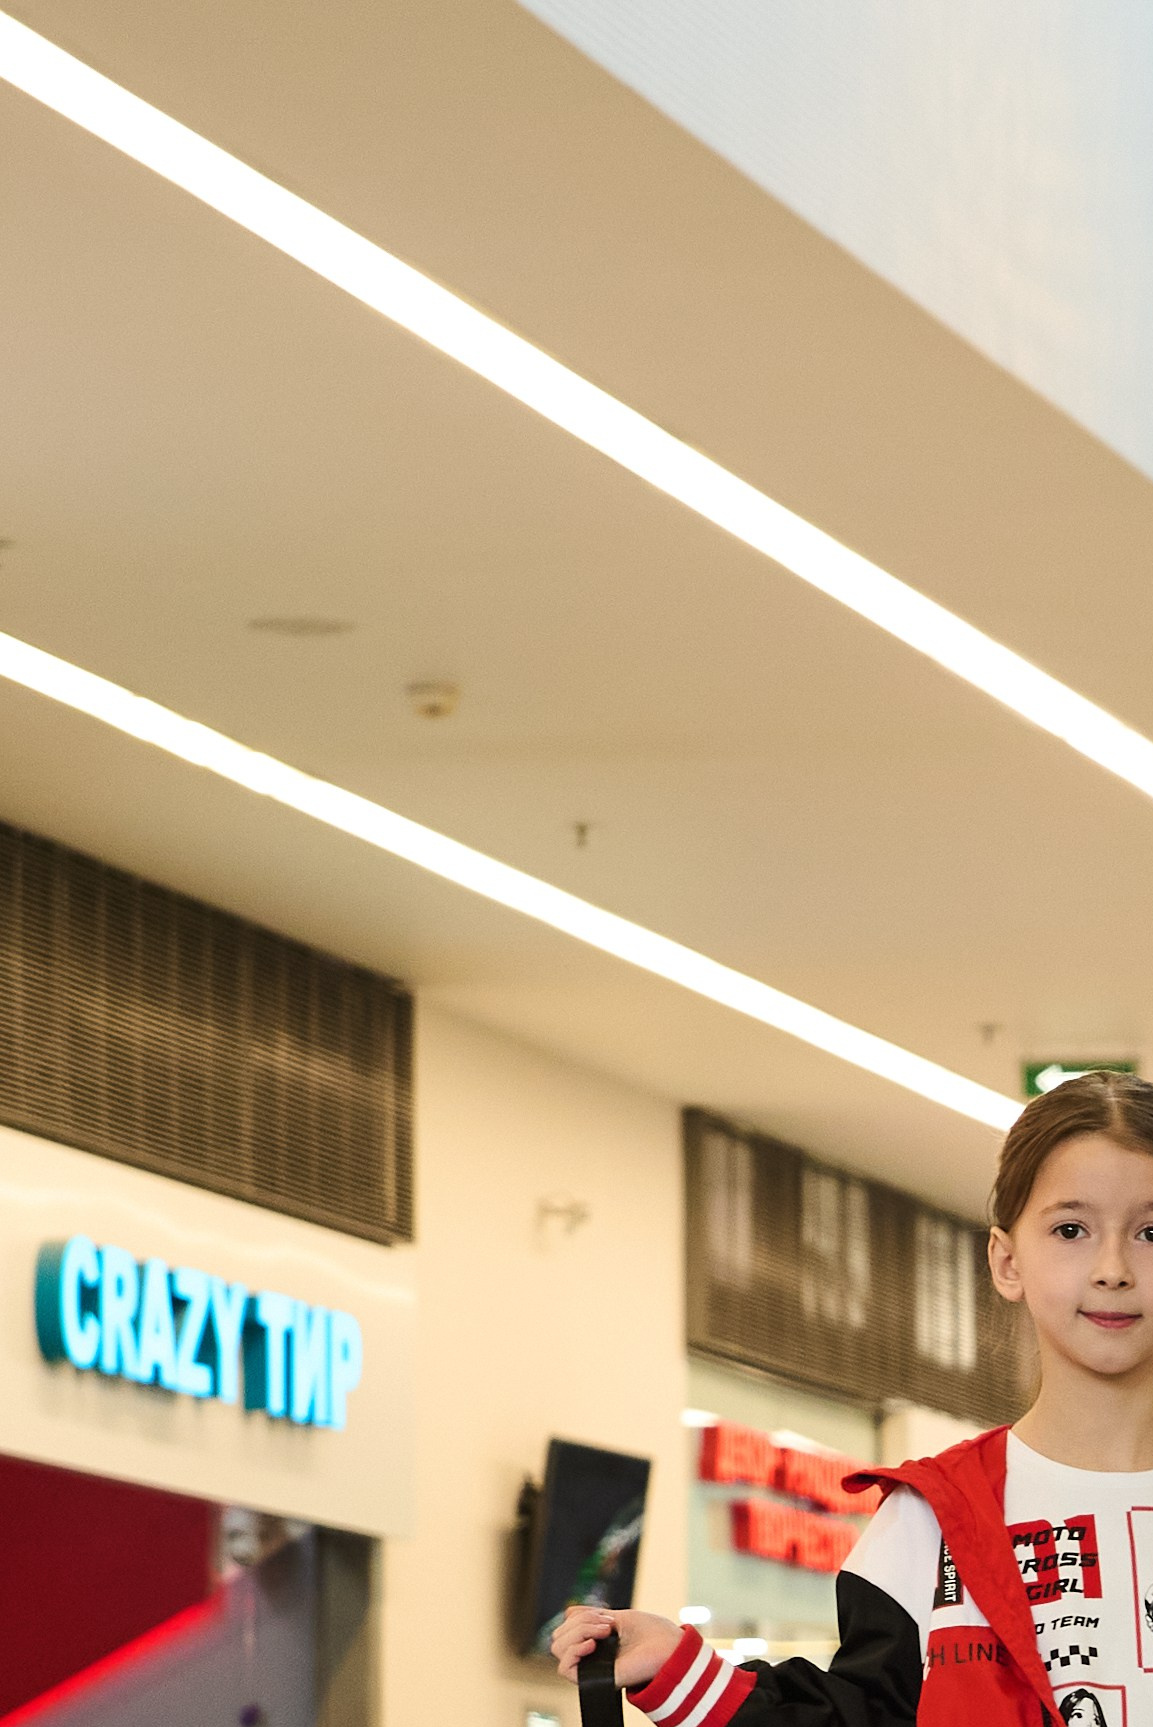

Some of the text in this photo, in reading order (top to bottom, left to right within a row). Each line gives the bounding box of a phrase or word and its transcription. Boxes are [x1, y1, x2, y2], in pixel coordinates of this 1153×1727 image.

[58, 1234, 249, 1404] CRAZY
[1012, 1526, 1086, 1549] MOTO
[1017, 1552, 1098, 1574] ROSS
[943, 1564, 957, 1602] SPIRIT
[1026, 1578, 1084, 1601] GIRL
[1051, 1615, 1100, 1630] TEAM
[929, 1644, 945, 1668] H
